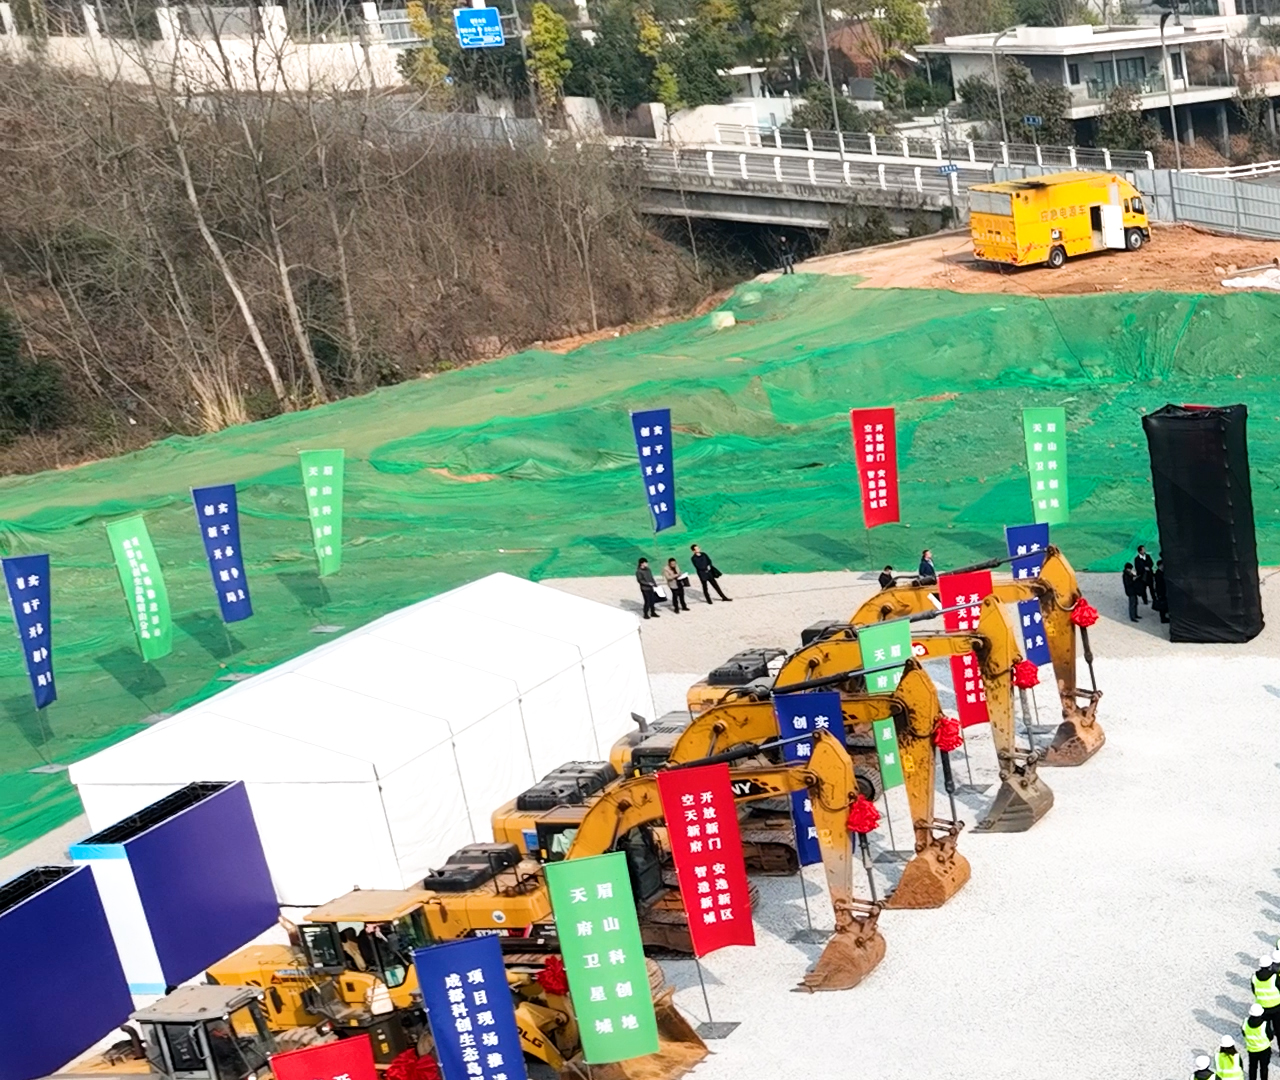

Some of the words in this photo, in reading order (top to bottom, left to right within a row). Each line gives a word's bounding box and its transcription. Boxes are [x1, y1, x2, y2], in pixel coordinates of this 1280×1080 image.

[681, 792, 704, 854] 空天新府
[694, 864, 718, 926] 智造新城
[700, 791, 723, 851] 开放新门
[712, 862, 735, 922] 安逸新区
[570, 887, 615, 1036] 天府卫星城
[597, 882, 640, 1032] 眉山科创地
